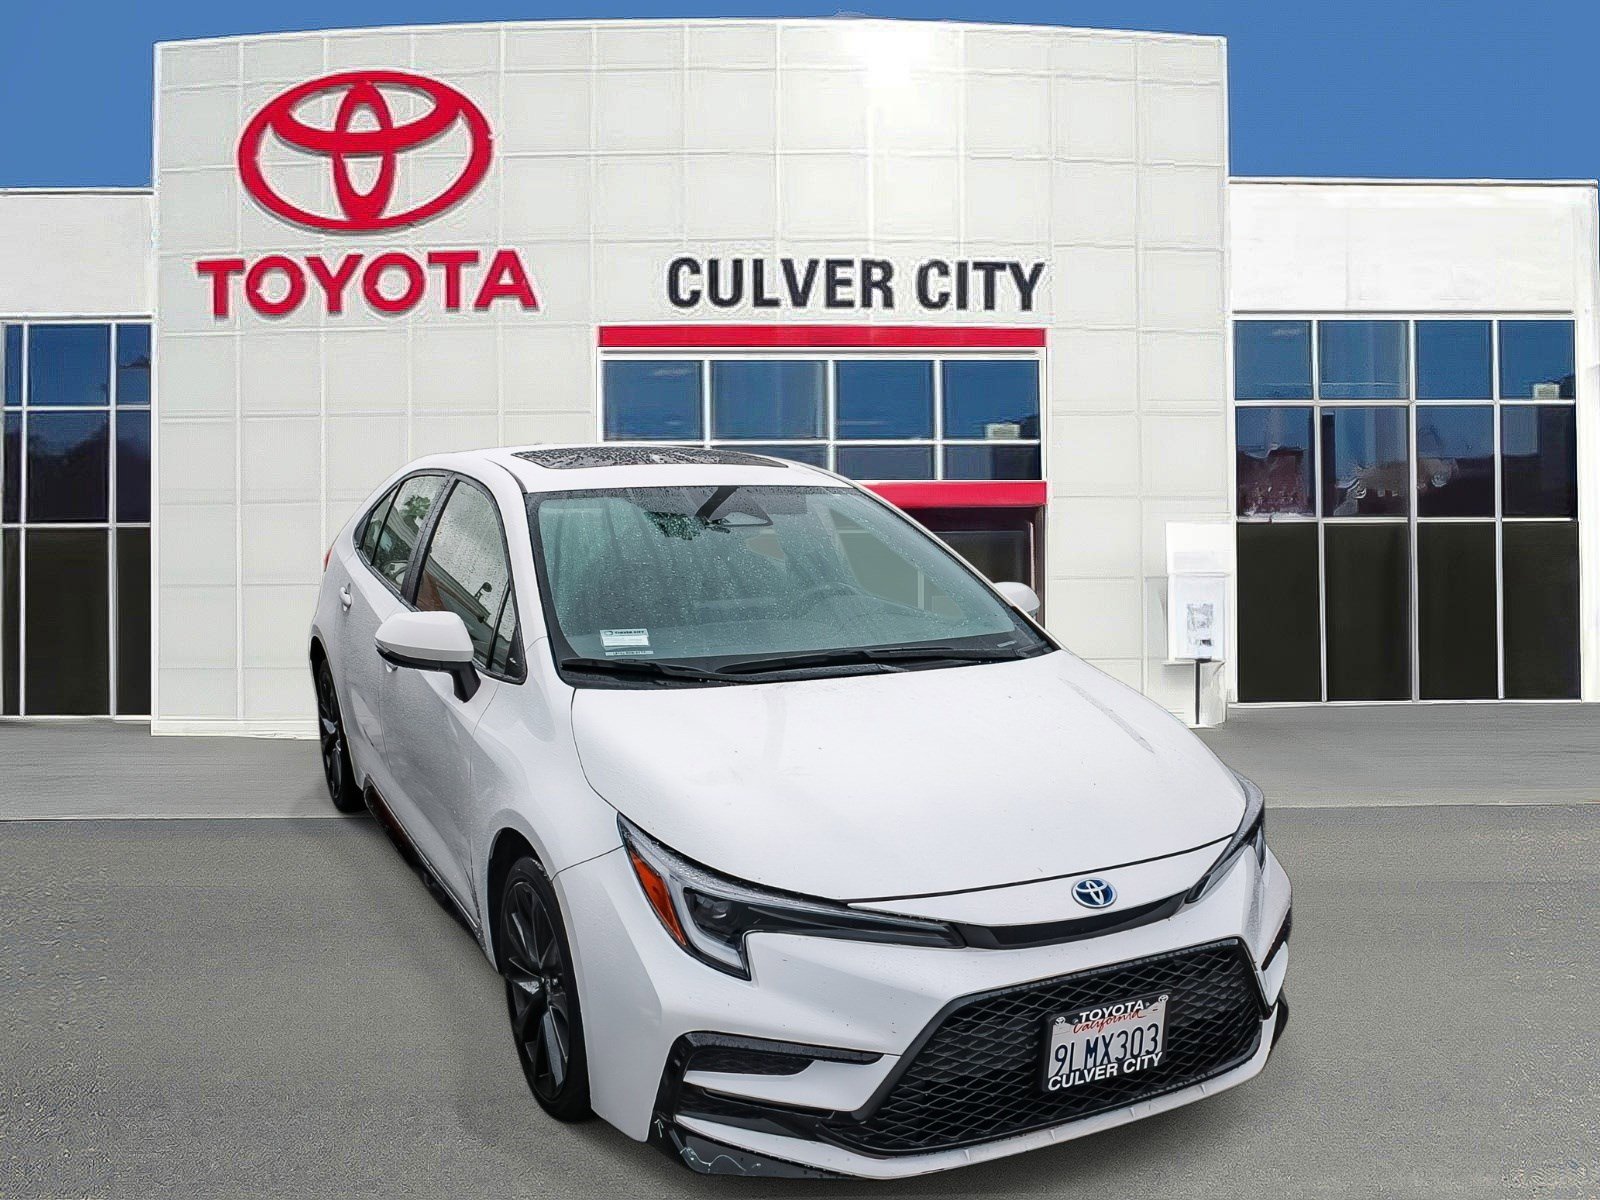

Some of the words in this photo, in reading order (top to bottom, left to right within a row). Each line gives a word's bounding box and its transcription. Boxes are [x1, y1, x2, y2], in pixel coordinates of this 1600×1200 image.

[195, 249, 540, 318] TOYOTA
[667, 258, 894, 309] CULVER
[914, 259, 1046, 311] CITY
[1073, 1009, 1147, 1034] California
[1079, 1000, 1145, 1023] TOYOTA
[1048, 1063, 1118, 1091] CULVER
[1123, 1051, 1163, 1074] CITY
[1054, 1022, 1159, 1076] 9LMX303
